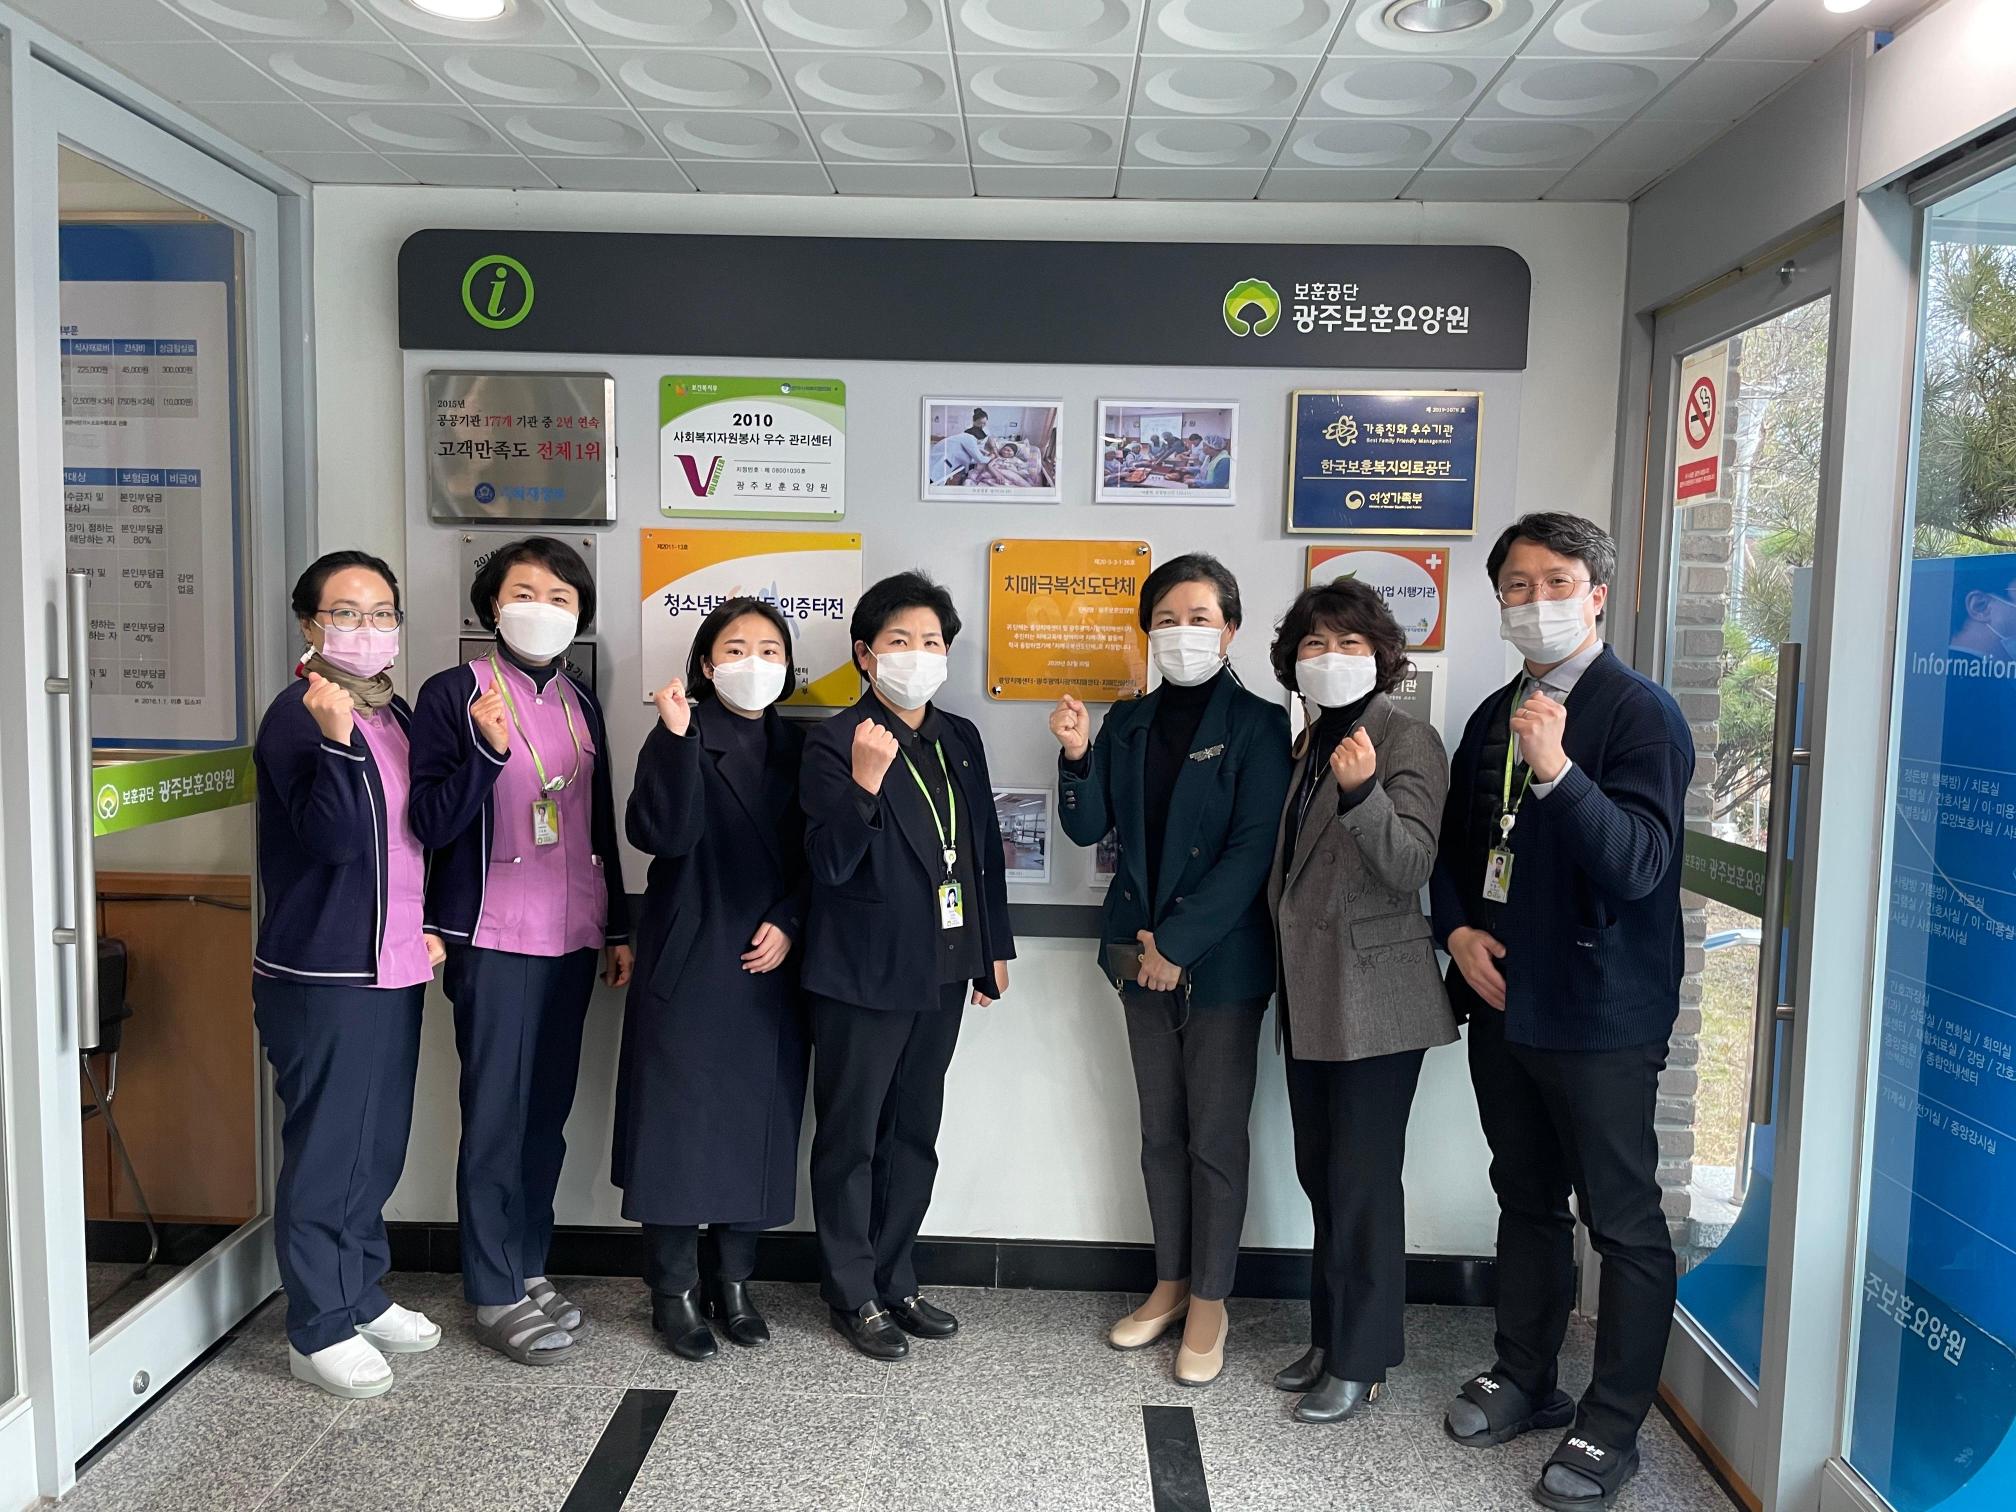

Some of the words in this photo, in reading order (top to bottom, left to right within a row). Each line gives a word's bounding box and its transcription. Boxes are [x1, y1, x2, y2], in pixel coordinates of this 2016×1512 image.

[1294, 282, 1359, 301] 보훈공단
[1292, 303, 1469, 335] 광주보훈요양원
[75, 343, 110, 353] 식사재료비
[124, 343, 146, 353] 간식비
[437, 399, 466, 409] 2015년
[437, 414, 481, 428] 공공기관
[485, 414, 512, 428] 177개
[516, 415, 538, 429] 기관
[541, 416, 553, 429] 중
[556, 416, 573, 430] 2년
[577, 416, 600, 430] 연속
[733, 413, 773, 427] 2010
[1363, 423, 1408, 437] 가족친화
[1411, 424, 1454, 437] 우수기관
[673, 431, 760, 446] 사회복지자원봉사
[764, 433, 785, 446] 우수
[789, 434, 833, 447] 관리센터
[437, 440, 530, 460] 고객만족도
[536, 440, 572, 461] 전체
[577, 441, 600, 462] 1위
[1320, 459, 1451, 476] 한국보훈복지의료공단
[122, 473, 160, 484] 보험급여
[169, 473, 198, 485] 비급여
[707, 458, 726, 496] VOLUNTEER
[64, 492, 92, 502] 수급자
[95, 492, 104, 502] 및
[120, 492, 162, 503] 본인부담금
[1369, 491, 1423, 504] 여성가족부
[132, 505, 151, 513] 80%
[88, 523, 114, 533] 정하는
[121, 524, 164, 534] 본인부담금
[69, 534, 104, 544] 해당하는
[106, 535, 115, 545] 자
[133, 536, 152, 544] 80%
[97, 568, 106, 577] 및
[121, 568, 165, 579] 본인부담금
[177, 573, 194, 583] 감면
[134, 580, 153, 589] 60%
[177, 585, 194, 595] 없음
[1004, 575, 1136, 597] 치매극복선도단체
[1370, 585, 1395, 598] 사업
[1397, 585, 1437, 599] 시행기관
[780, 596, 844, 620] 인증터전
[123, 622, 165, 633] 본인부담금
[108, 631, 117, 641] 자
[135, 634, 153, 643] 40%
[1912, 651, 2016, 679] Information
[98, 669, 107, 678] 및
[123, 669, 166, 679] 본인부담금
[135, 680, 154, 689] 60%
[159, 767, 236, 804] 광주보훈요양원
[1971, 779, 2000, 797] 치료실
[122, 785, 154, 806] 보훈공단
[1935, 792, 1971, 812] 간호사실
[1941, 812, 1993, 836] 요양보호사실
[1958, 892, 1985, 912] 치료실
[1926, 902, 1961, 925] 간호사실
[1971, 915, 2016, 941] 이·미용실
[1916, 919, 1969, 946] 사회복지사실
[1889, 980, 1931, 1008] 간호과장실
[1910, 1007, 1936, 1028] 상담실
[1945, 1020, 1972, 1045] 면회실
[1982, 1036, 2012, 1061] 회의실
[1915, 1029, 1958, 1057] 재활치료실
[1967, 1049, 1986, 1069] 강당
[1926, 1050, 1979, 1087] 종합안내센터
[1915, 1103, 1941, 1127] 전기실
[1950, 1120, 1997, 1155] 중앙감시실
